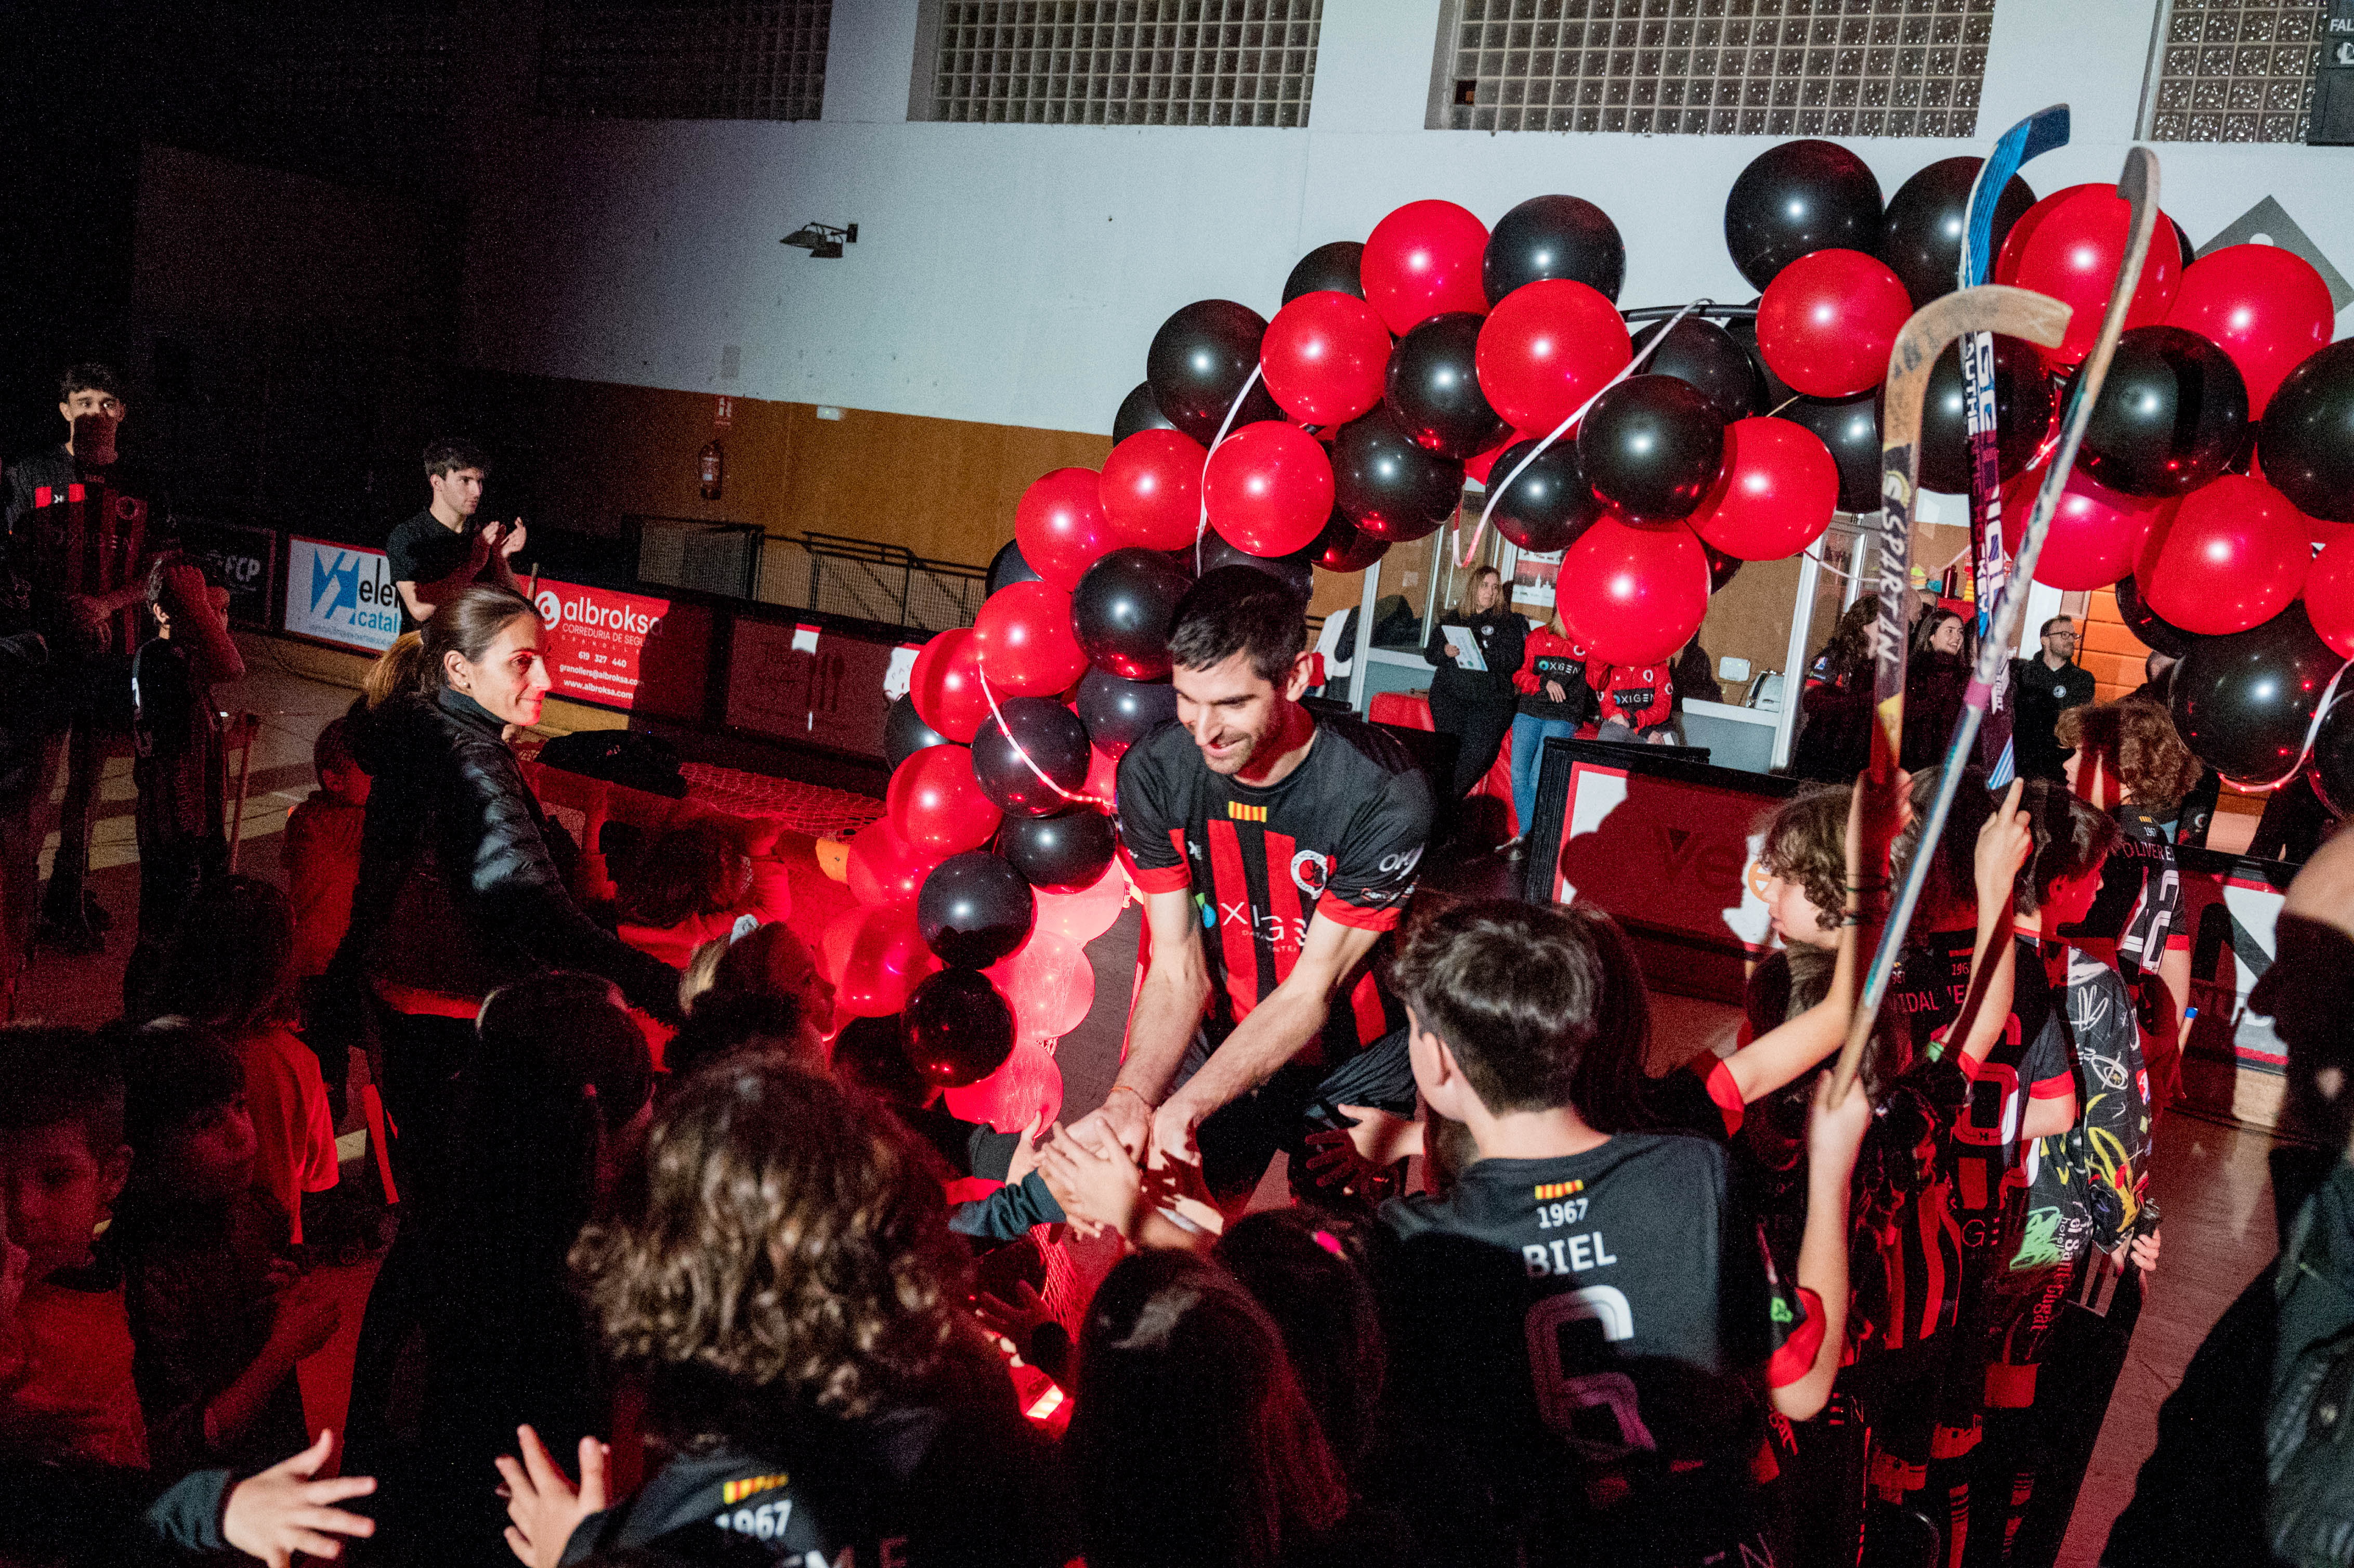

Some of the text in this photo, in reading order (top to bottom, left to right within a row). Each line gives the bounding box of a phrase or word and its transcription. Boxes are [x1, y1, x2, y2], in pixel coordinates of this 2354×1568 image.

[1878, 506, 1907, 663] SPARTAN
[358, 611, 401, 633] catal
[564, 597, 663, 635] albroksa
[562, 623, 611, 641] CORREDURIA
[612, 632, 623, 643] DE
[559, 663, 645, 686] granollers@albroksa.com
[578, 651, 627, 668] 619 327 440
[564, 679, 634, 700] www.albroksa.com
[2123, 841, 2165, 860] OLIVER
[1537, 1197, 1589, 1230] 1967
[2055, 1217, 2071, 1248] hotel
[1523, 1231, 1617, 1277] BIEL
[2054, 1239, 2080, 1279] Sant
[2030, 1284, 2064, 1332] Cugat
[1524, 1285, 1657, 1462] 6
